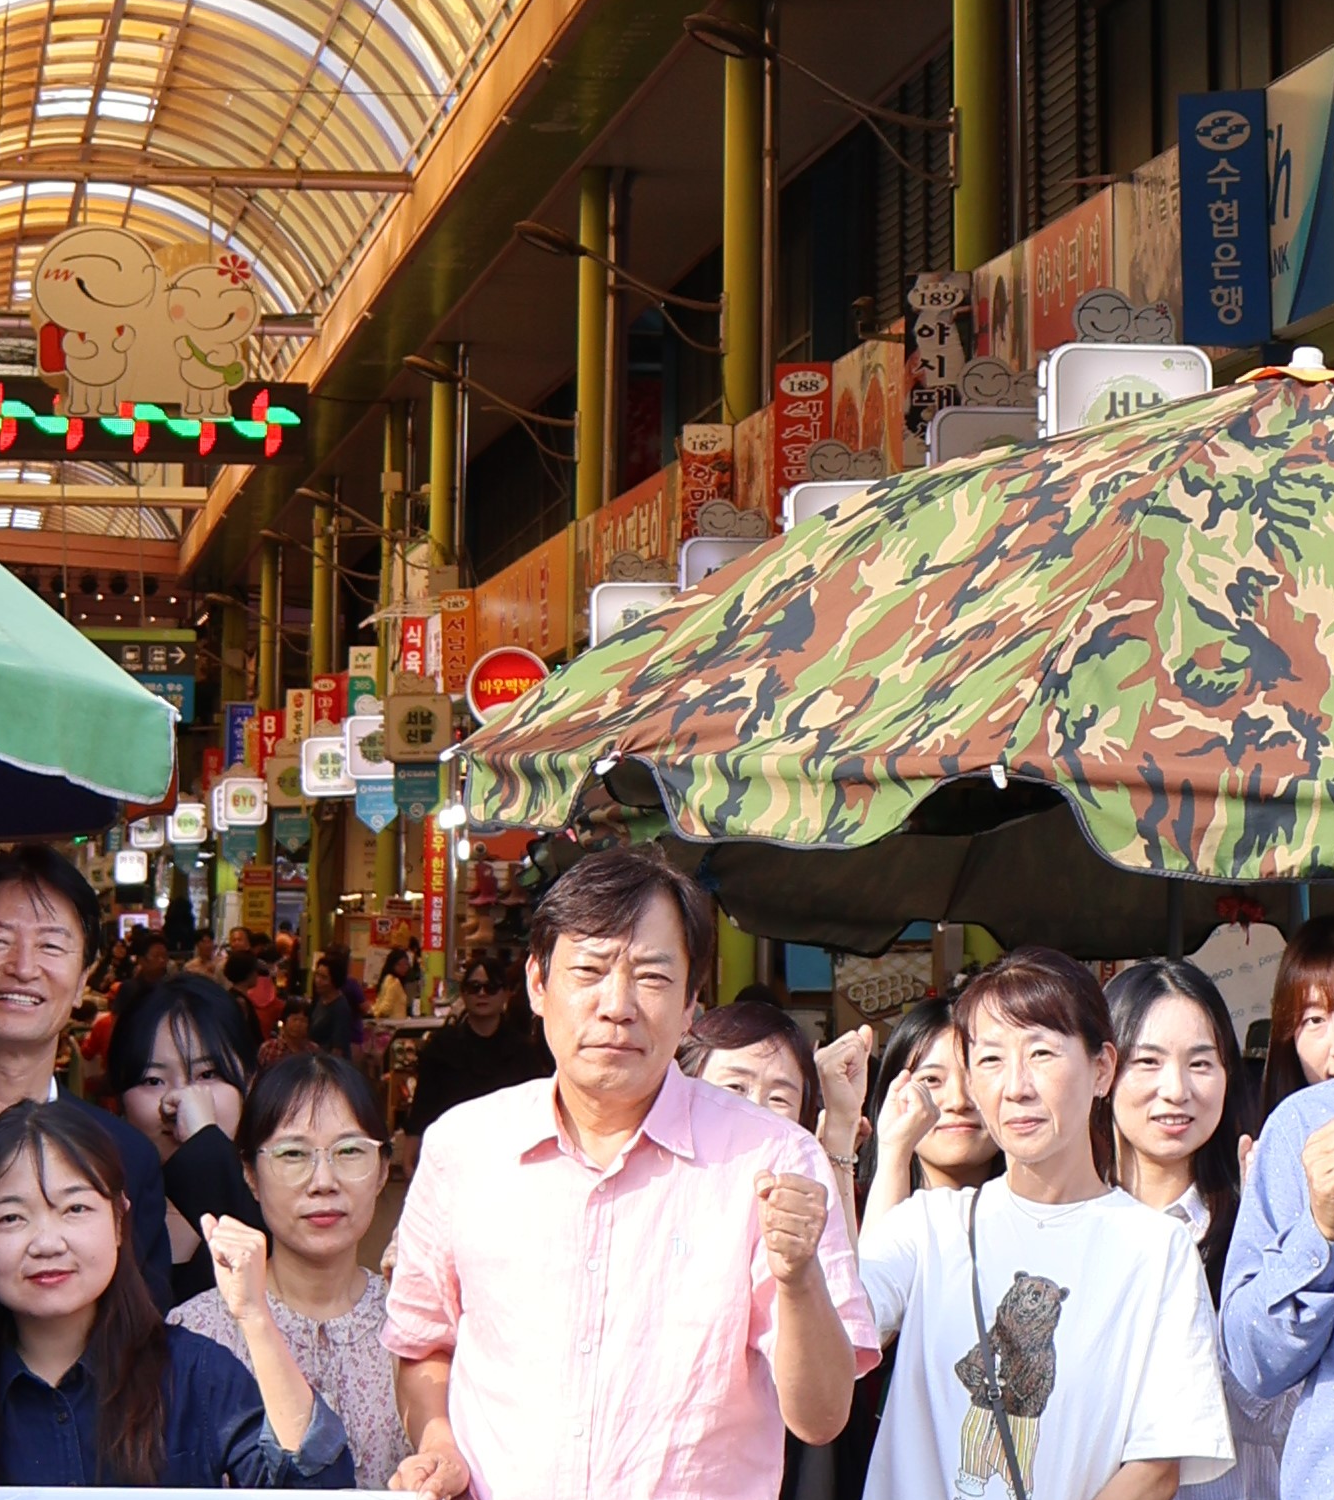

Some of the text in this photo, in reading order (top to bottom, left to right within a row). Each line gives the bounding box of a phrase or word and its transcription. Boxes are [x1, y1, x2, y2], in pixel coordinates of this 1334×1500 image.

[1267, 123, 1292, 226] h
[1207, 158, 1243, 325] 수협은행
[1271, 241, 1289, 278] NK
[918, 291, 957, 307] 189
[789, 380, 820, 393] 188
[692, 441, 718, 450] 187
[446, 616, 467, 688] 서남신발
[406, 711, 433, 725] 서남
